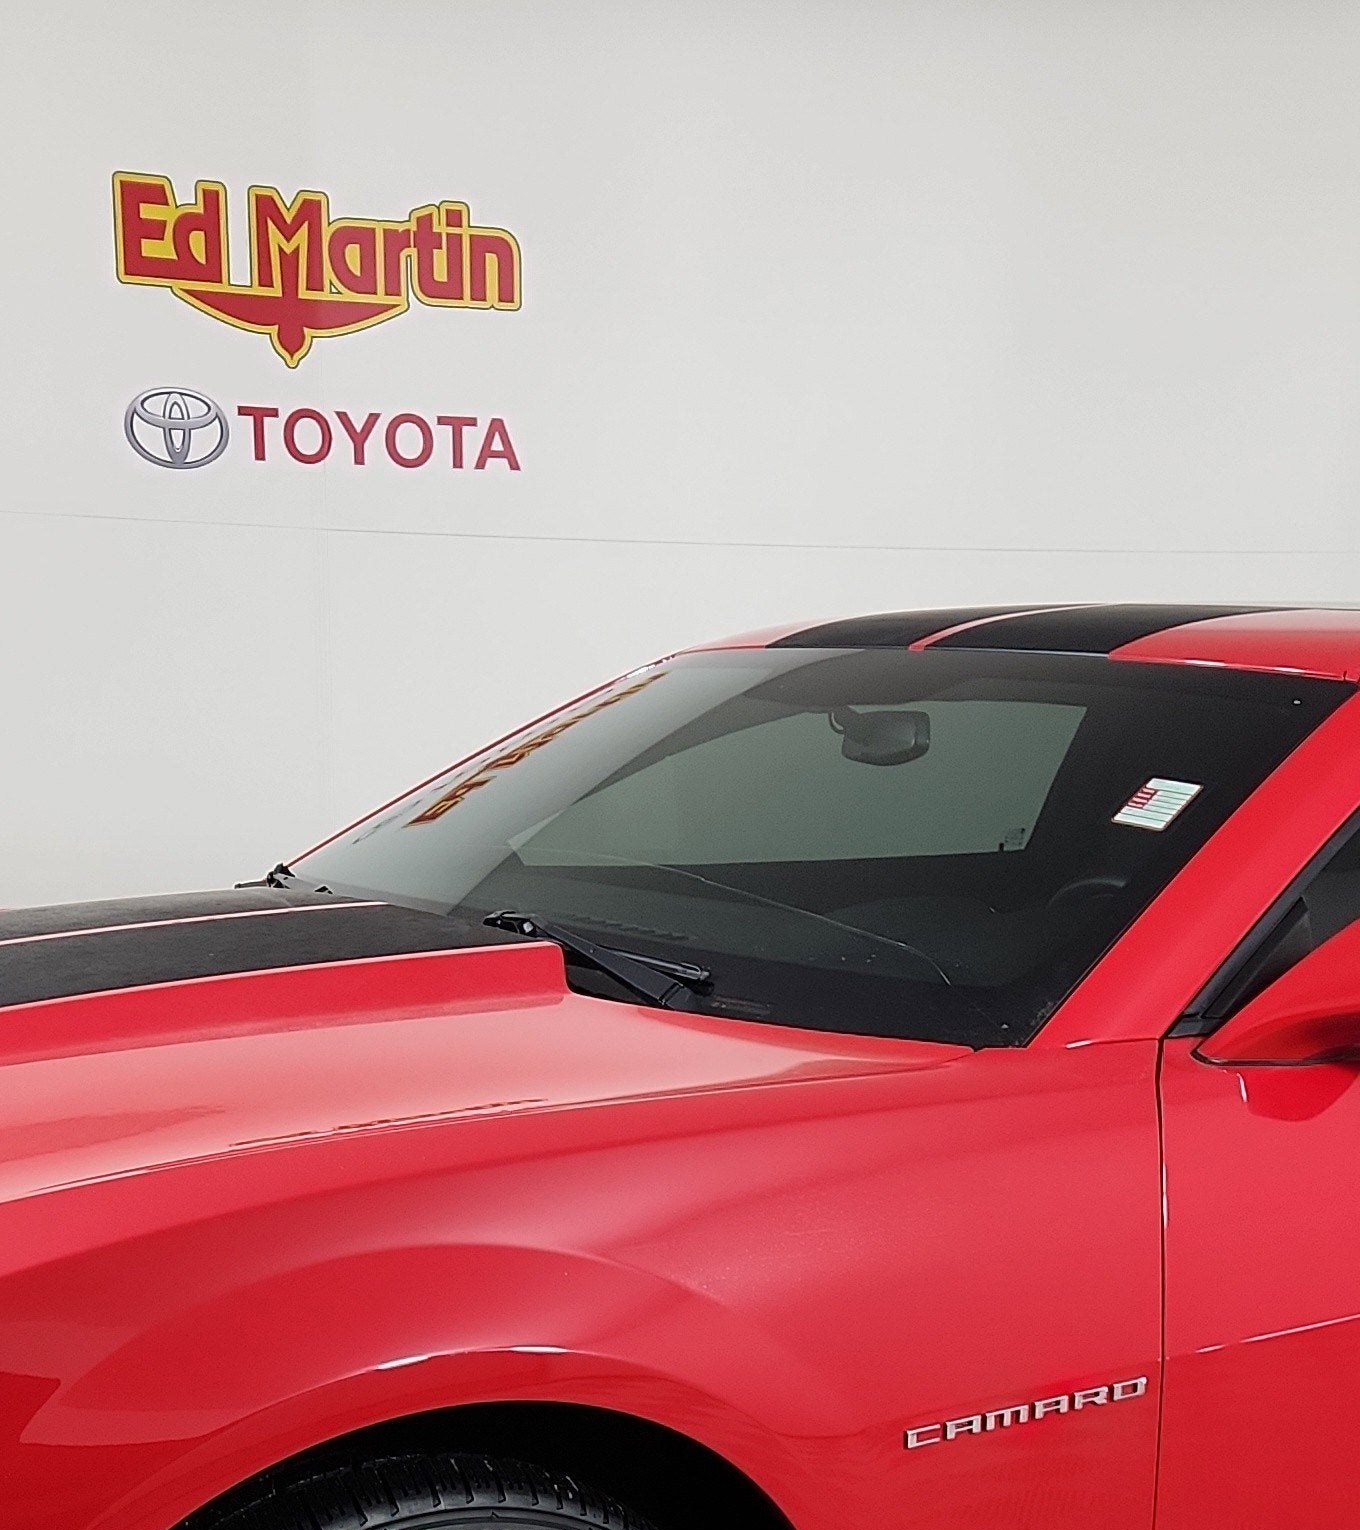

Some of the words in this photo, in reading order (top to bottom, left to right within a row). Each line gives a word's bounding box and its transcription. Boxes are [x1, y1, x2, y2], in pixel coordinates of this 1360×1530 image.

[116, 175, 226, 285] Ed
[250, 190, 518, 306] Martin
[237, 405, 521, 471] TOYOTA
[906, 1376, 1148, 1449] CAMARO
